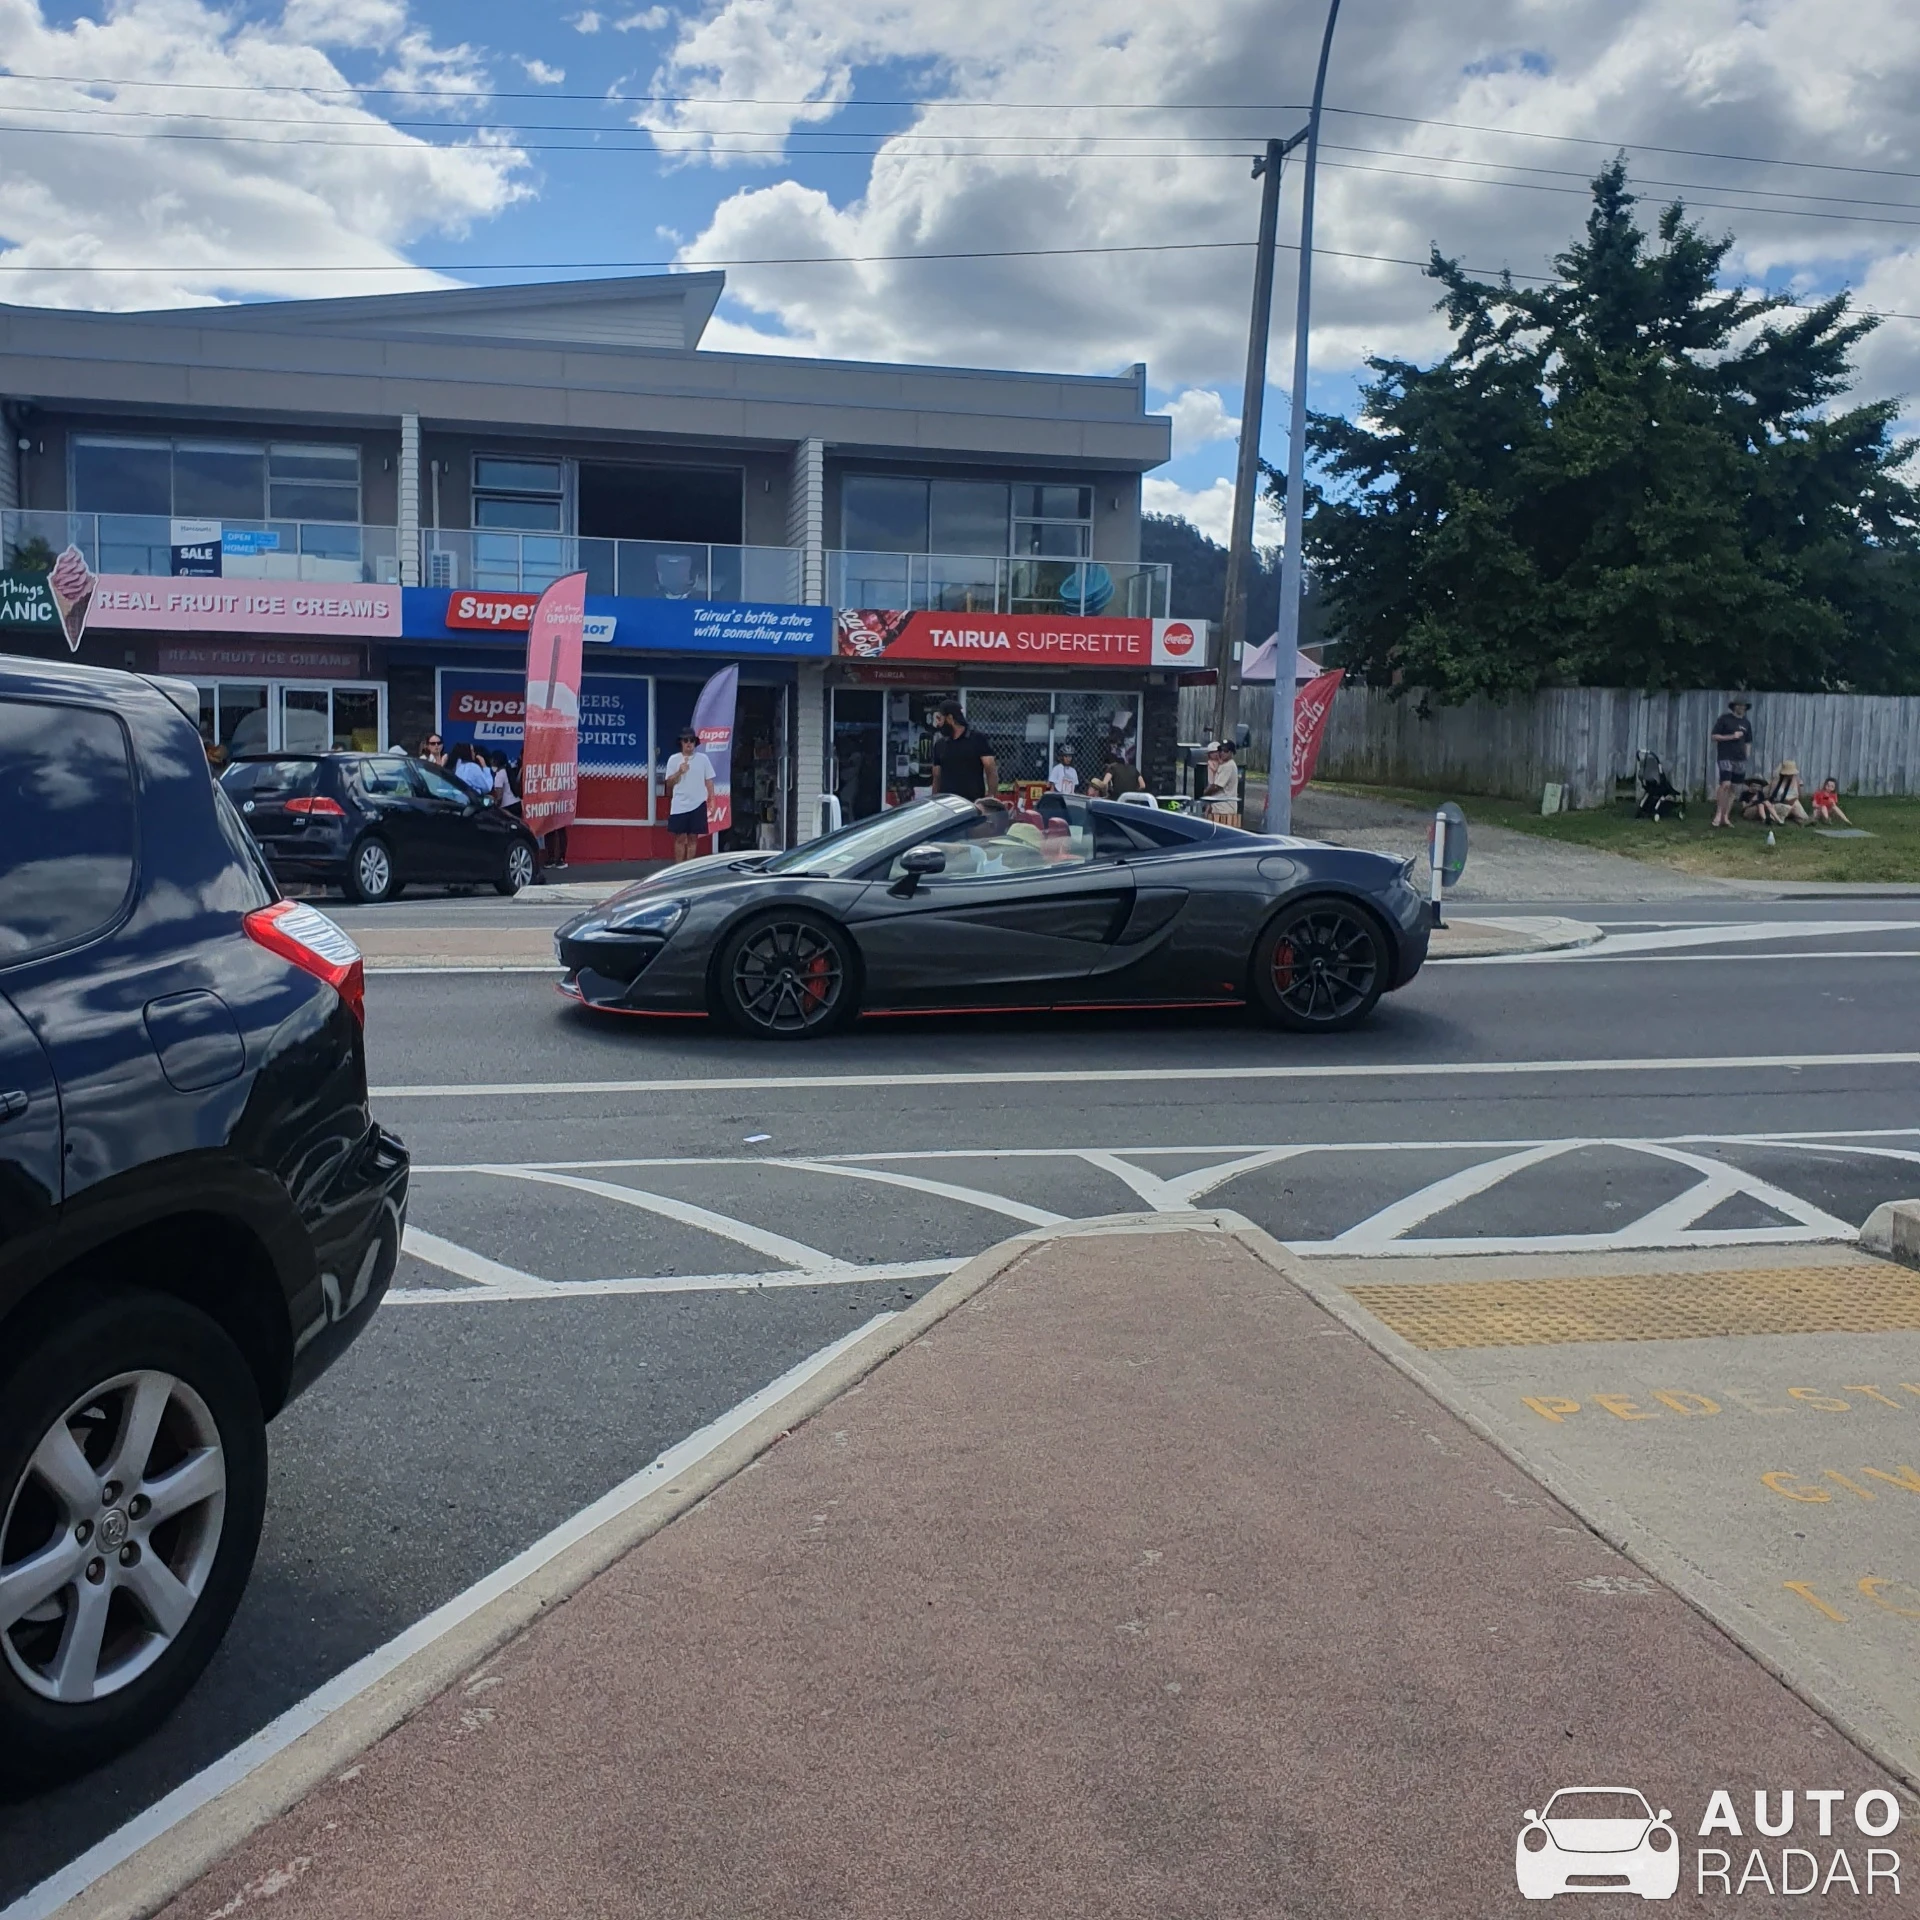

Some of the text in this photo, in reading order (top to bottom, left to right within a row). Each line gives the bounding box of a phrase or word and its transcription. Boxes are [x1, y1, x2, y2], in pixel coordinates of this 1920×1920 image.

[227, 533, 252, 541] OPEN
[180, 547, 214, 560] SALE
[223, 544, 256, 554] HOMES
[0, 577, 44, 601] things
[0, 600, 52, 621] ANIC
[99, 590, 390, 619] REAL FRUIT ICE CREAMS
[693, 608, 813, 627] Tairua's bottle store
[693, 623, 814, 644] with something more
[930, 629, 1141, 653] TAIRUA SUPERETTE
[581, 695, 624, 710] EERS,
[481, 723, 524, 736] Liquo
[698, 729, 730, 741] Super
[525, 762, 576, 780] REAL FRUIT
[524, 777, 577, 794] ICE CREAMS
[525, 800, 575, 819] SMOOTHIES
[1521, 1383, 1920, 1422] PEDEST
